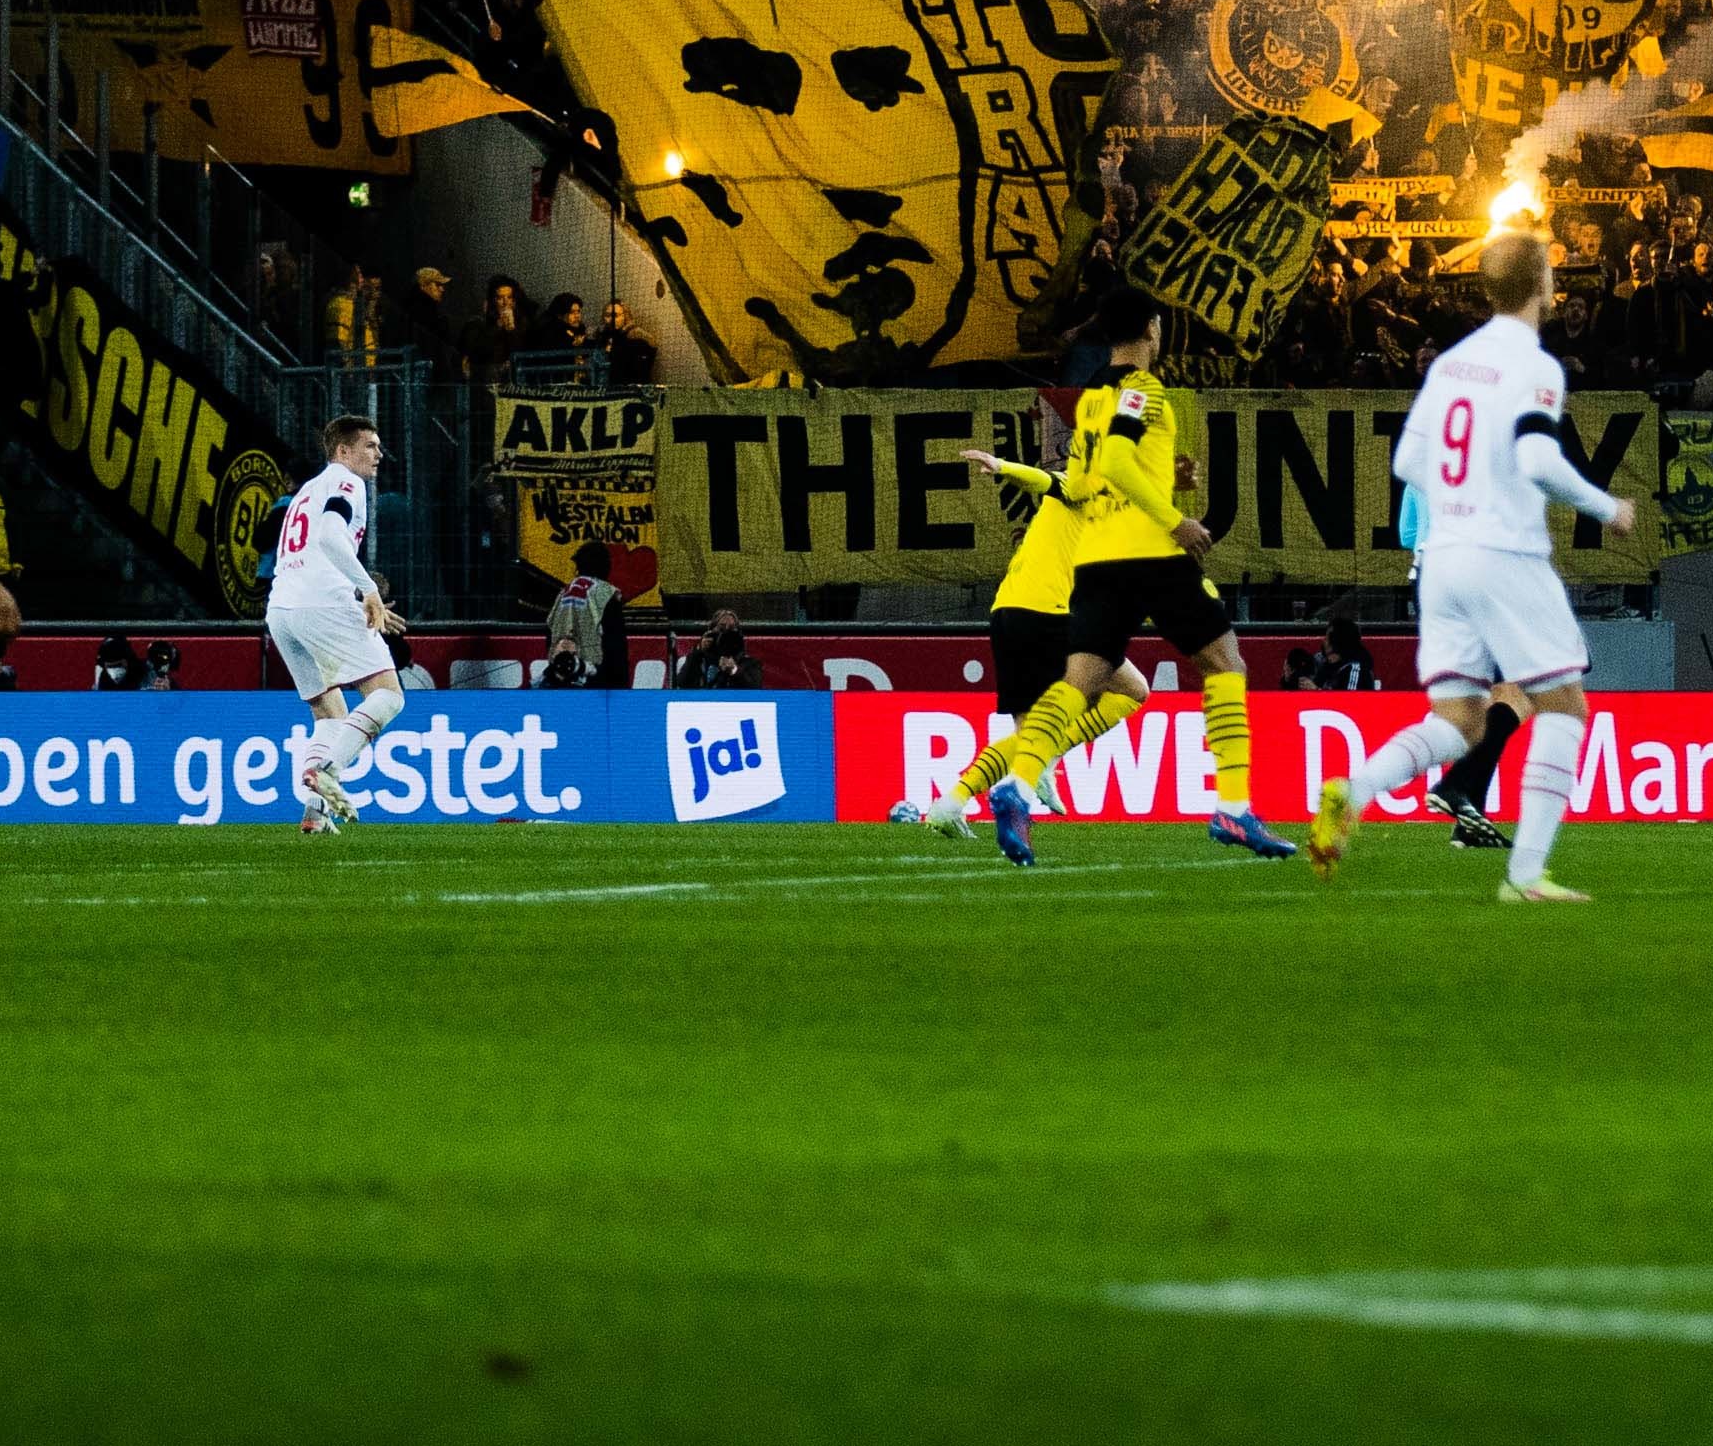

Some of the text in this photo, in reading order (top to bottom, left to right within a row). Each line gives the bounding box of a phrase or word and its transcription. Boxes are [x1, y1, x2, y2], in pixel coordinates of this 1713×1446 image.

[502, 402, 655, 453] AKLP
[1441, 397, 1475, 487] 9
[532, 485, 655, 525] WESTFALEN
[673, 412, 977, 552] THE
[1194, 410, 1644, 550] UNIY
[281, 495, 311, 559] 15
[550, 523, 639, 545] STADION
[686, 716, 762, 803] ja!
